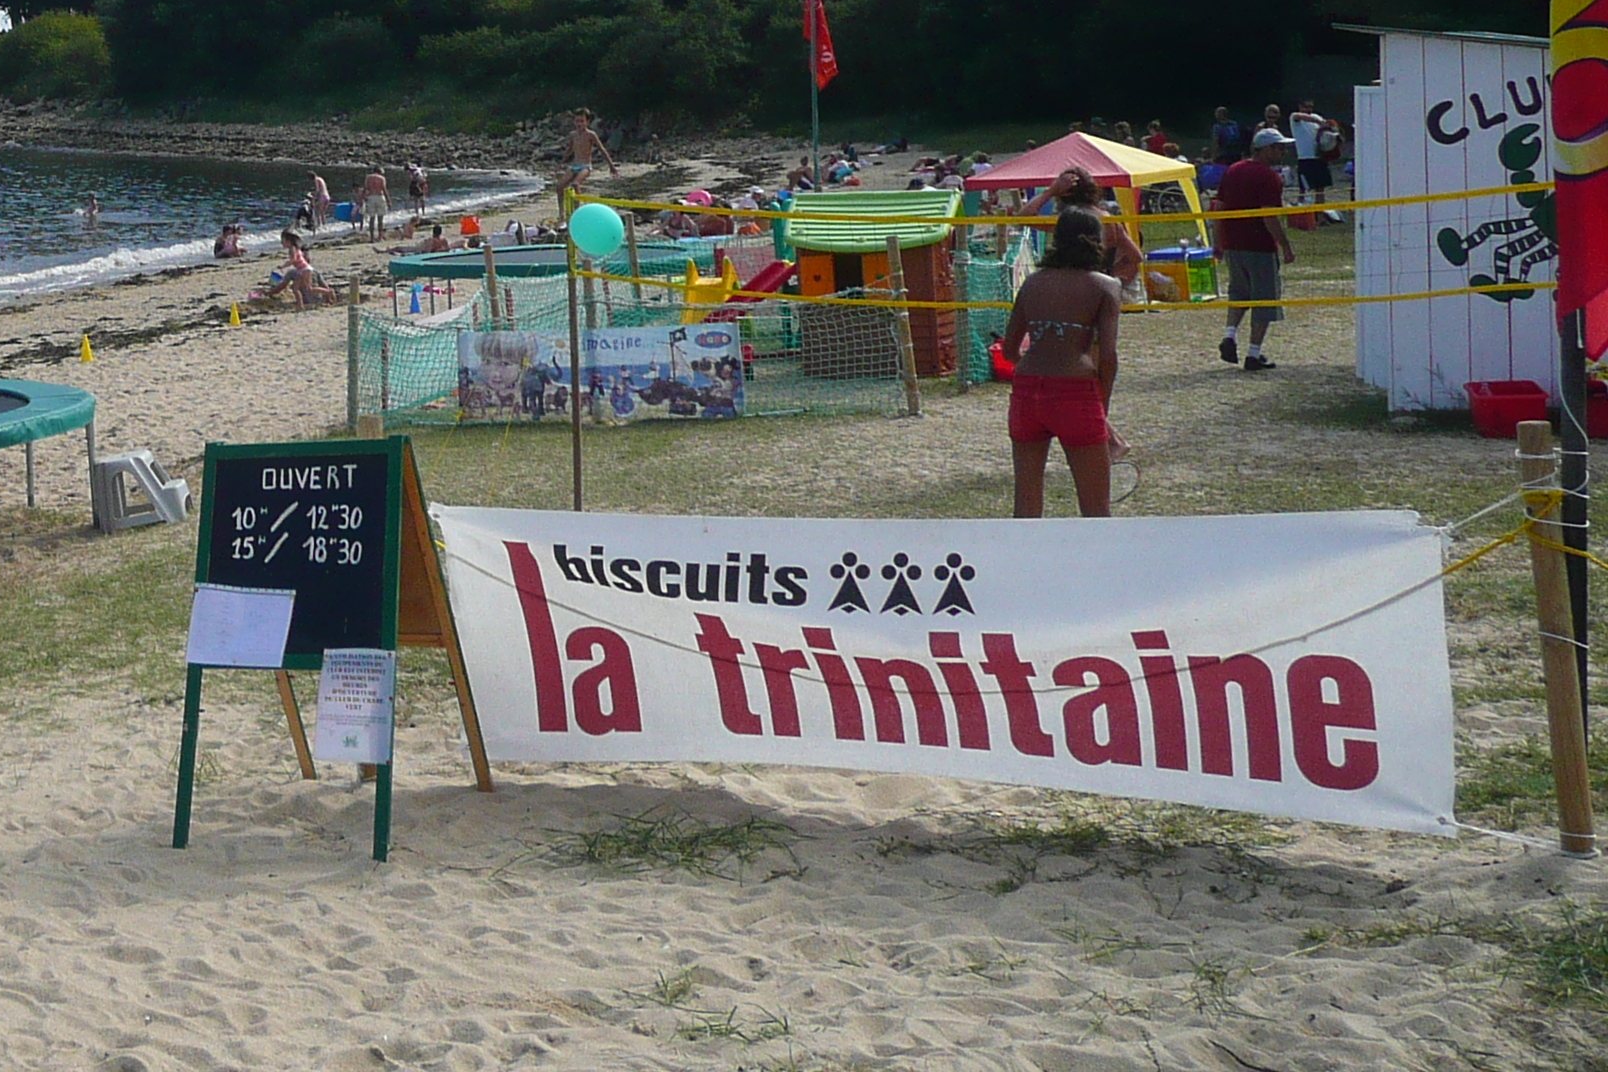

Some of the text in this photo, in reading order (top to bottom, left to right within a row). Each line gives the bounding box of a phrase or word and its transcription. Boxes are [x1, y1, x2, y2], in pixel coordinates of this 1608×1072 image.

[1427, 74, 1550, 144] CLU
[262, 464, 358, 490] OUVERT
[552, 544, 808, 606] biscuits
[501, 540, 1379, 791] la trinitaine
